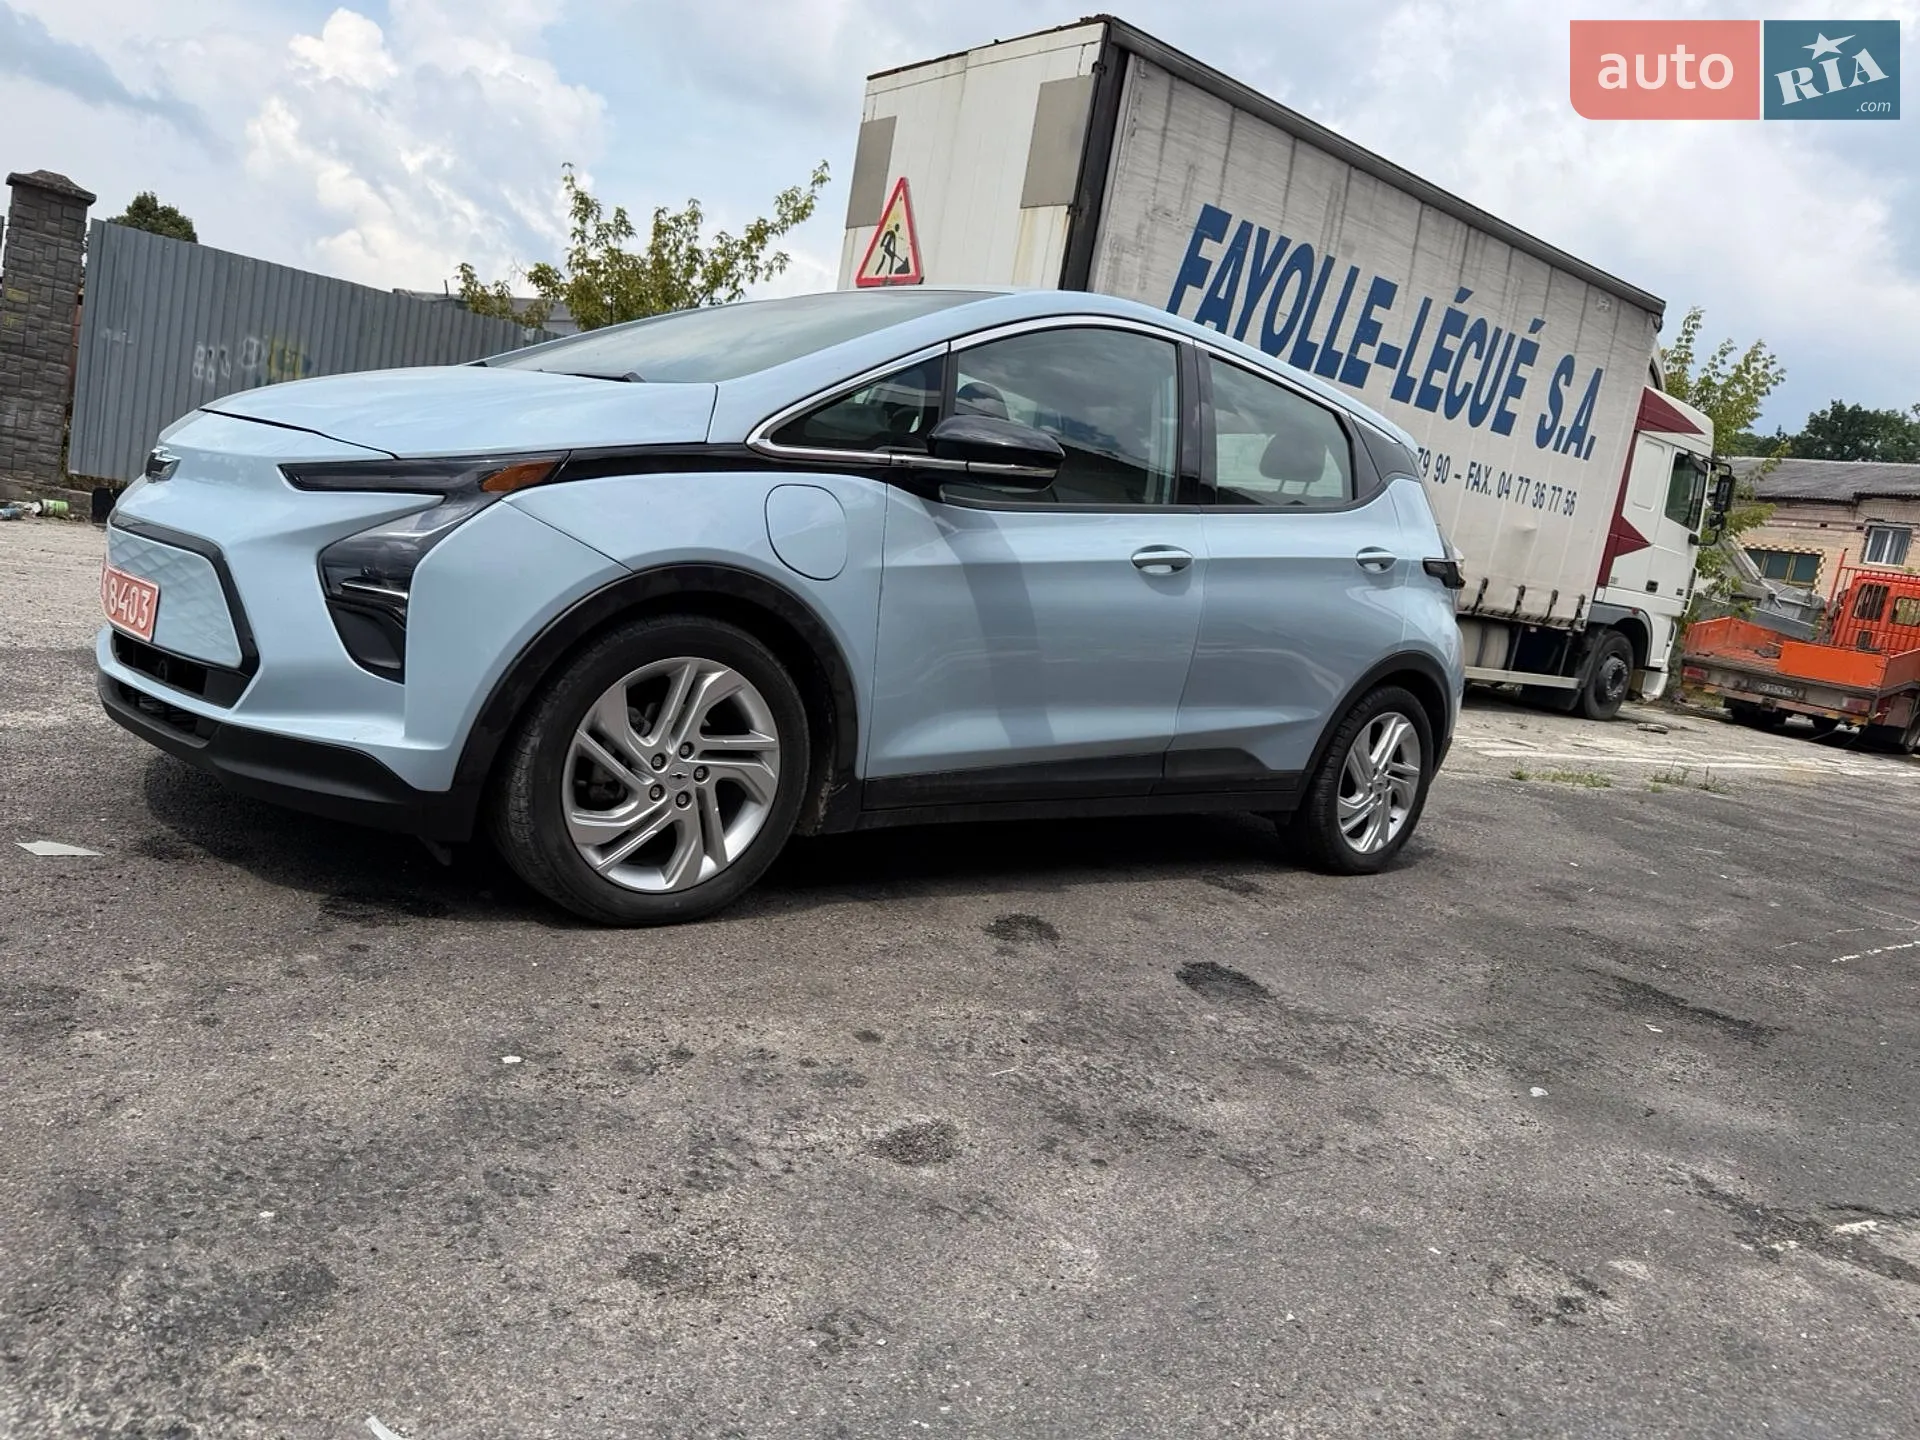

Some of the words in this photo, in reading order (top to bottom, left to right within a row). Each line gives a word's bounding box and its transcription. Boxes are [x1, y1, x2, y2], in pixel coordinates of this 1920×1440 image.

[1165, 203, 1546, 437] FAYOLLE-LÉCUÉ
[1535, 354, 1604, 461] S.A.
[1433, 453, 1451, 484] 90
[1465, 461, 1493, 496] FAX.
[1497, 471, 1512, 500] 04
[1515, 475, 1531, 505] 77
[1532, 481, 1547, 509] 36
[1548, 485, 1563, 513] 77
